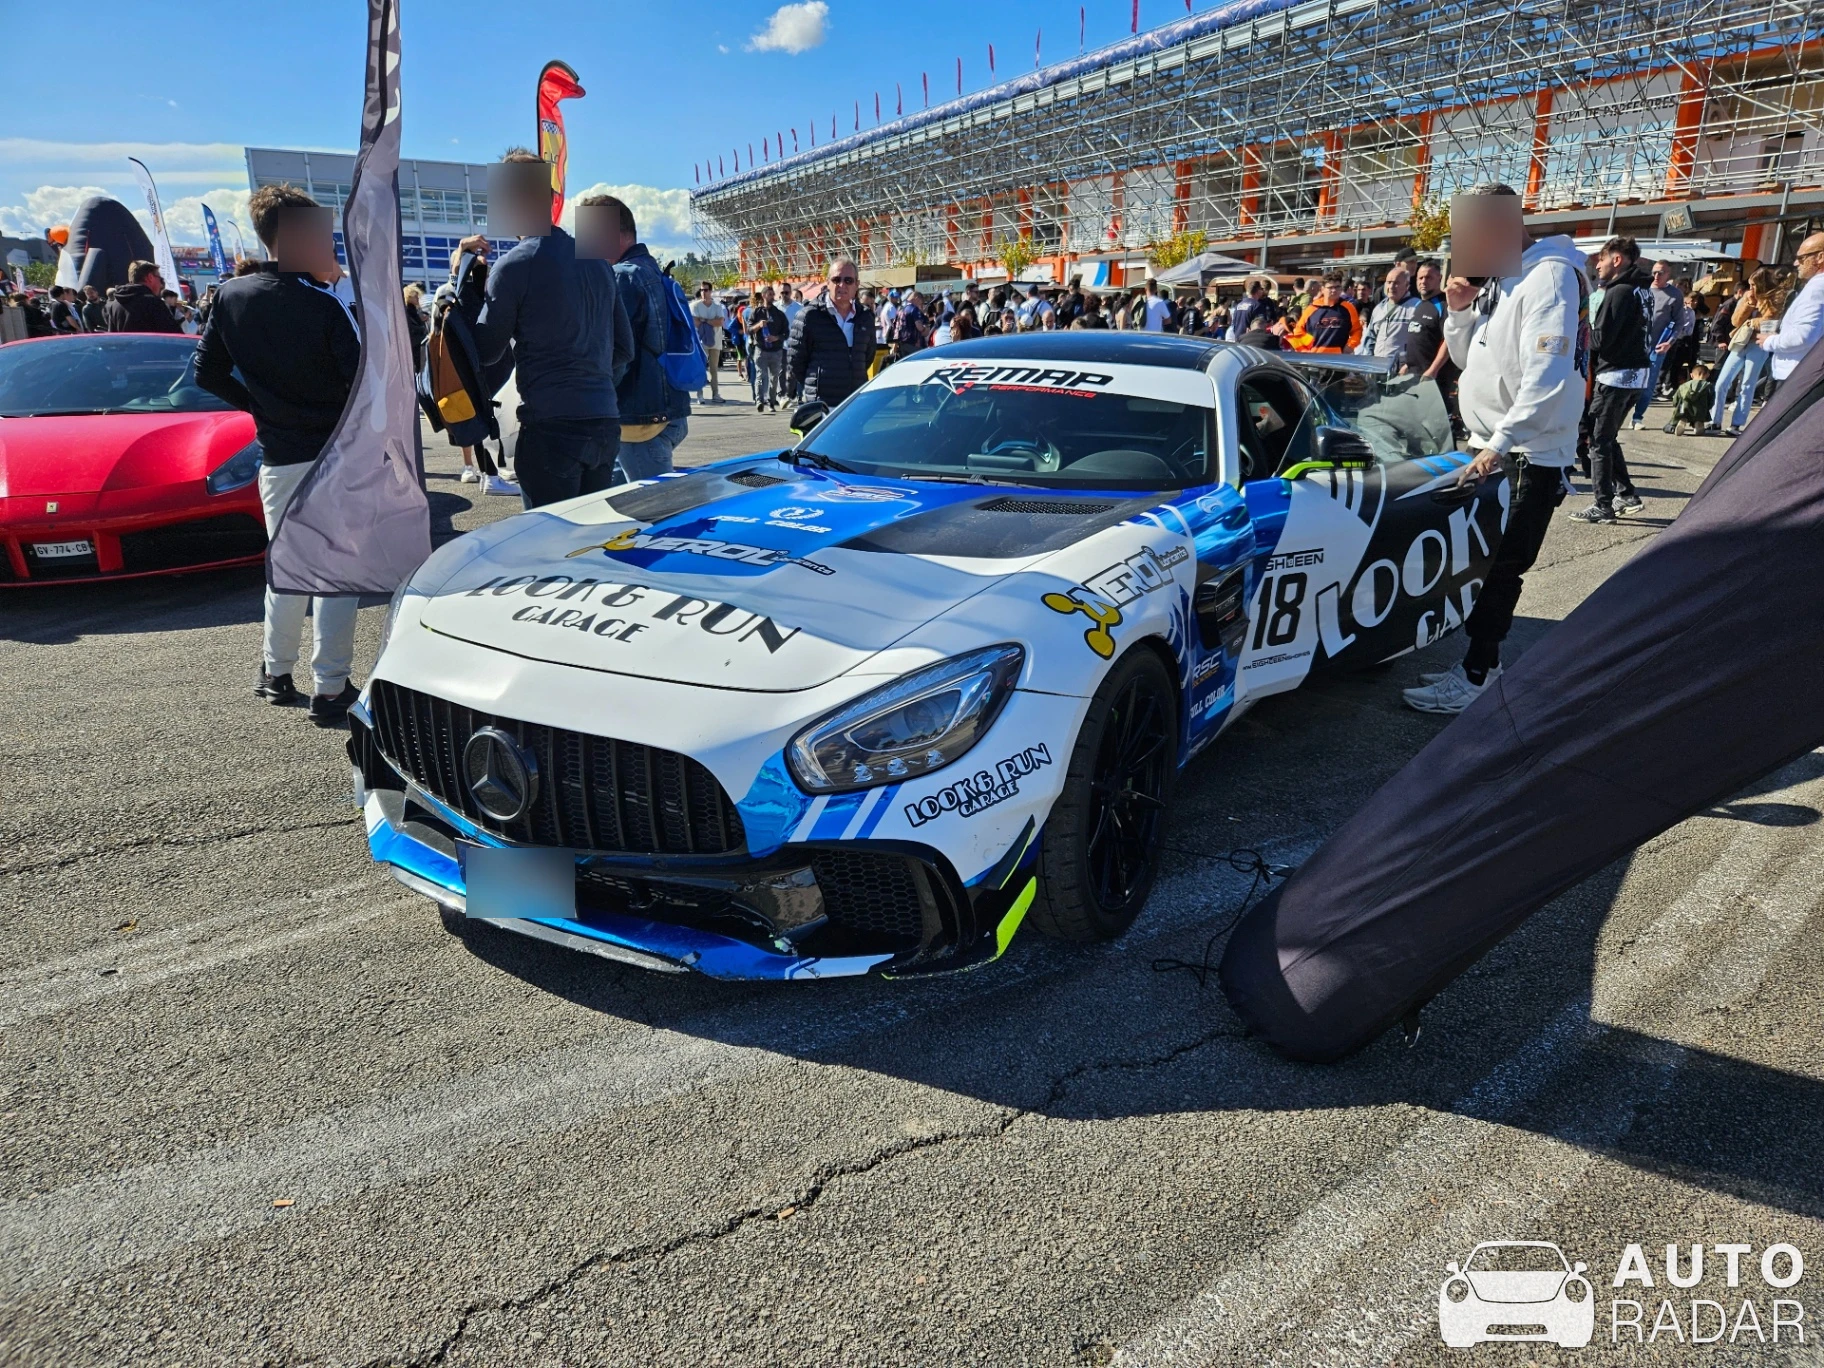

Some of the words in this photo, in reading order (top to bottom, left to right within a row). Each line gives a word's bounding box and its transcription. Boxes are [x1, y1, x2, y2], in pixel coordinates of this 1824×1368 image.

[921, 366, 1114, 393] REMAP
[989, 384, 1097, 399] PERFORMANCE
[1067, 552, 1174, 616] NEROL
[1316, 498, 1490, 658] LOOK
[465, 575, 606, 603] LOOK
[652, 595, 802, 654] RUN
[511, 605, 649, 643] GARAGE
[1252, 572, 1307, 651] 18
[1416, 578, 1484, 650] GAR
[1193, 651, 1222, 679] RSC
[1204, 684, 1225, 708] COLOR
[904, 778, 978, 827] LOOK
[996, 743, 1052, 783] RUN
[959, 781, 1019, 817] GARAGE
